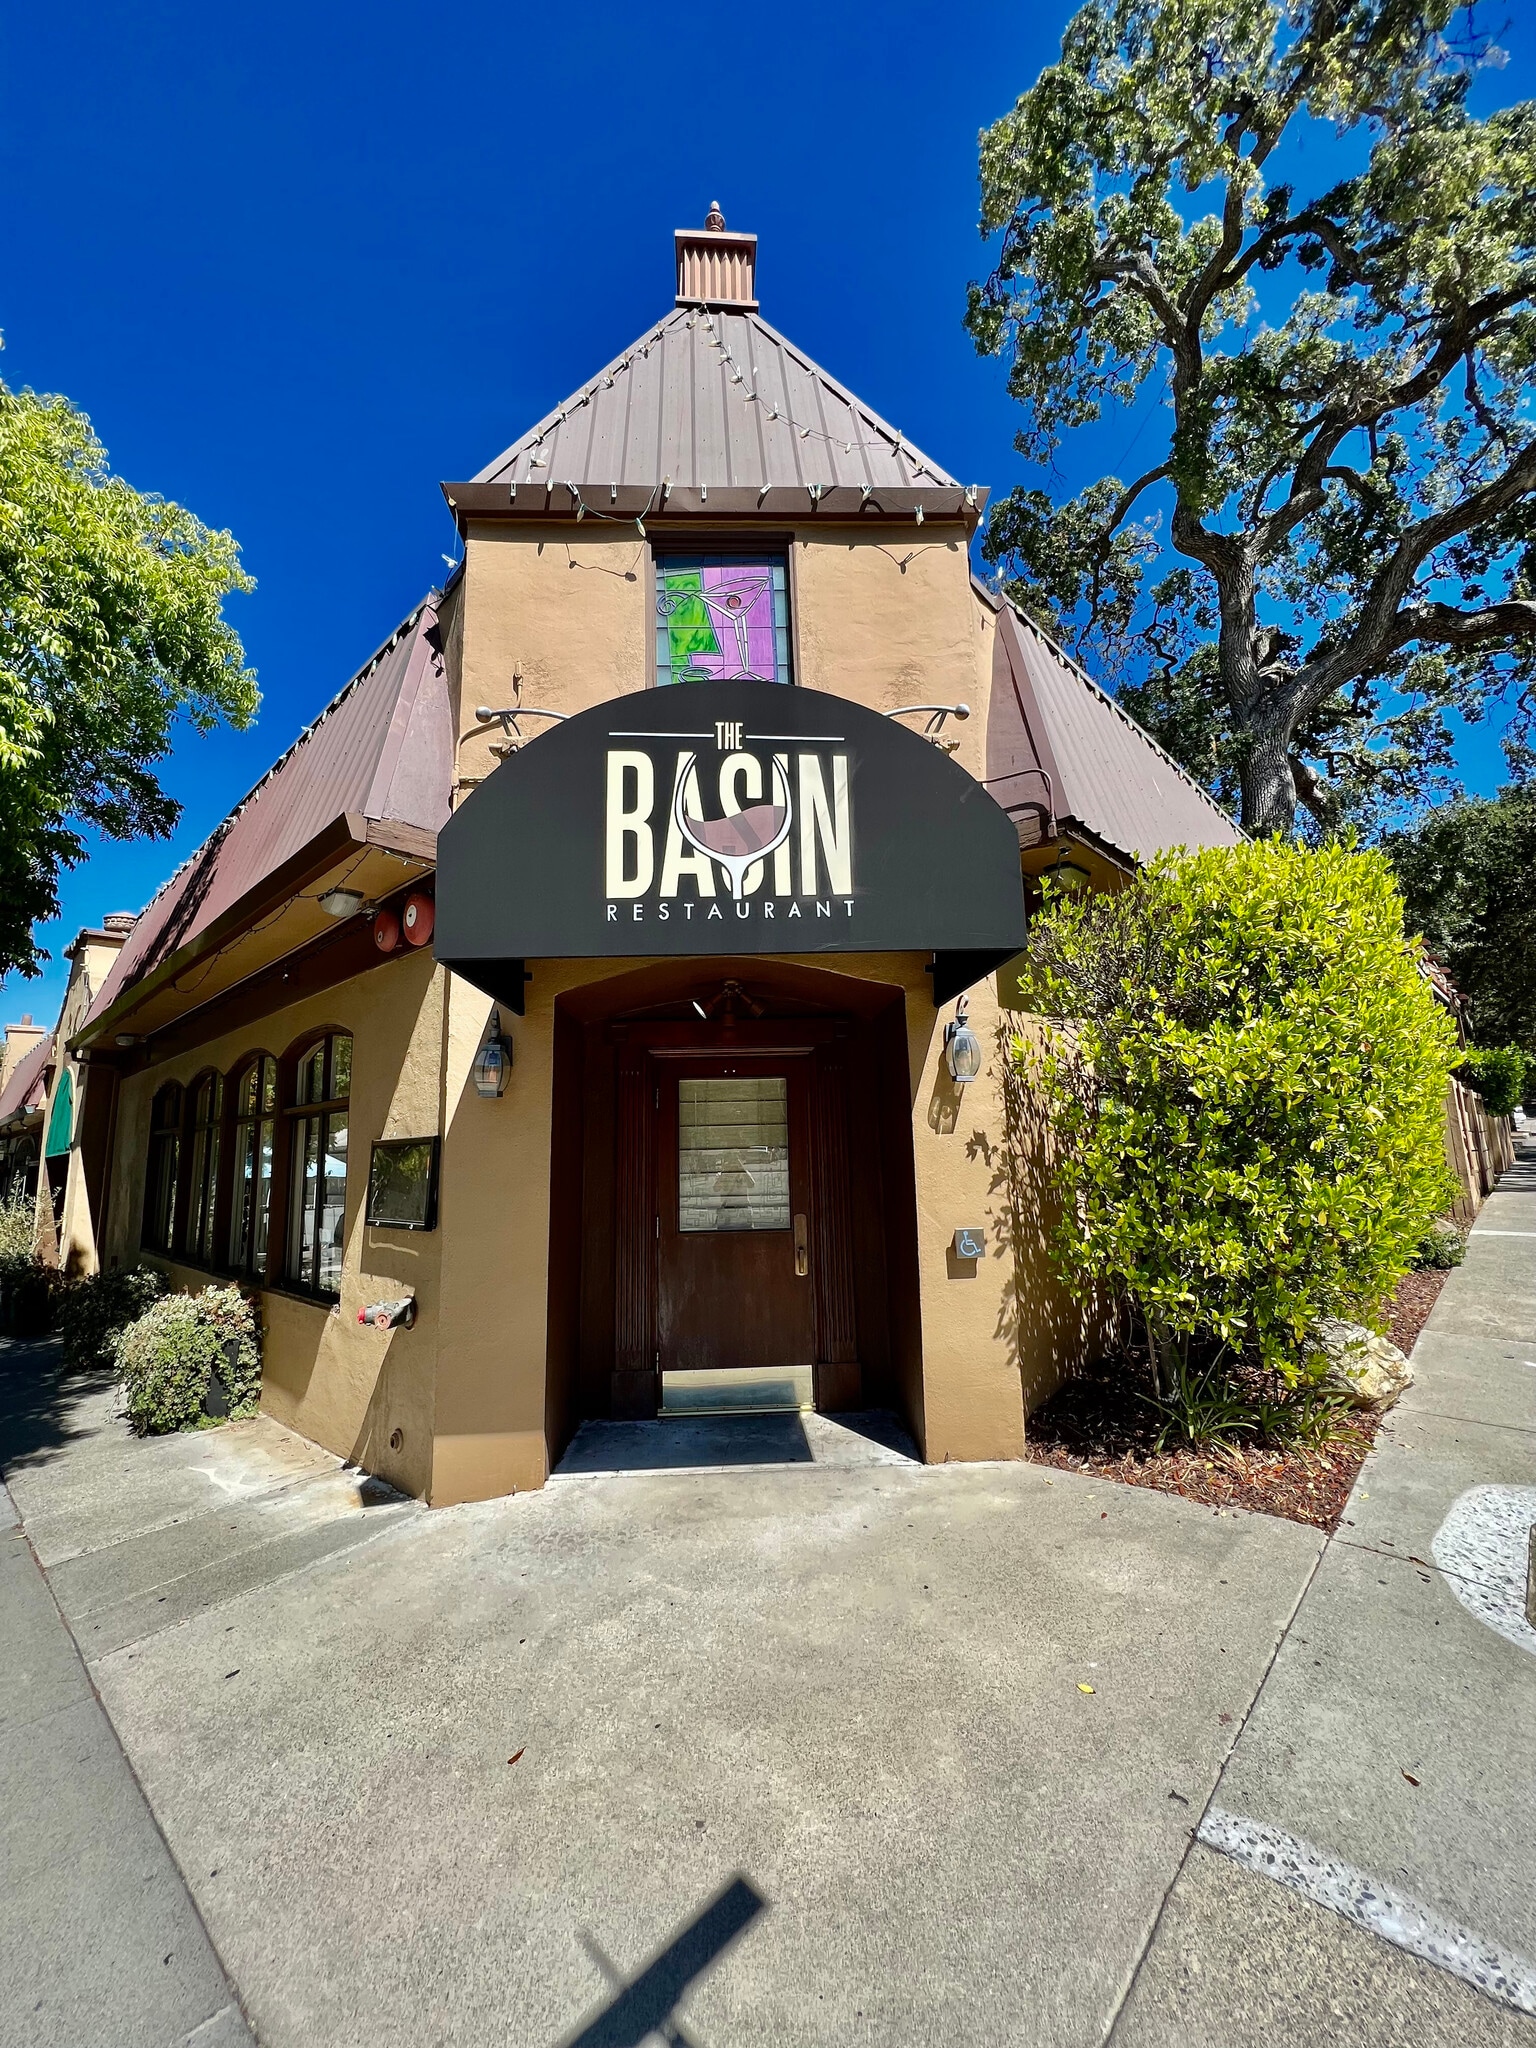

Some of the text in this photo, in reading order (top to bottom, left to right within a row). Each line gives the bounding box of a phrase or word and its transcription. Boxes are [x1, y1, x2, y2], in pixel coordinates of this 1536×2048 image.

[714, 721, 744, 750] THE
[605, 750, 853, 899] BASIN
[606, 900, 855, 922] RESTAURANT
